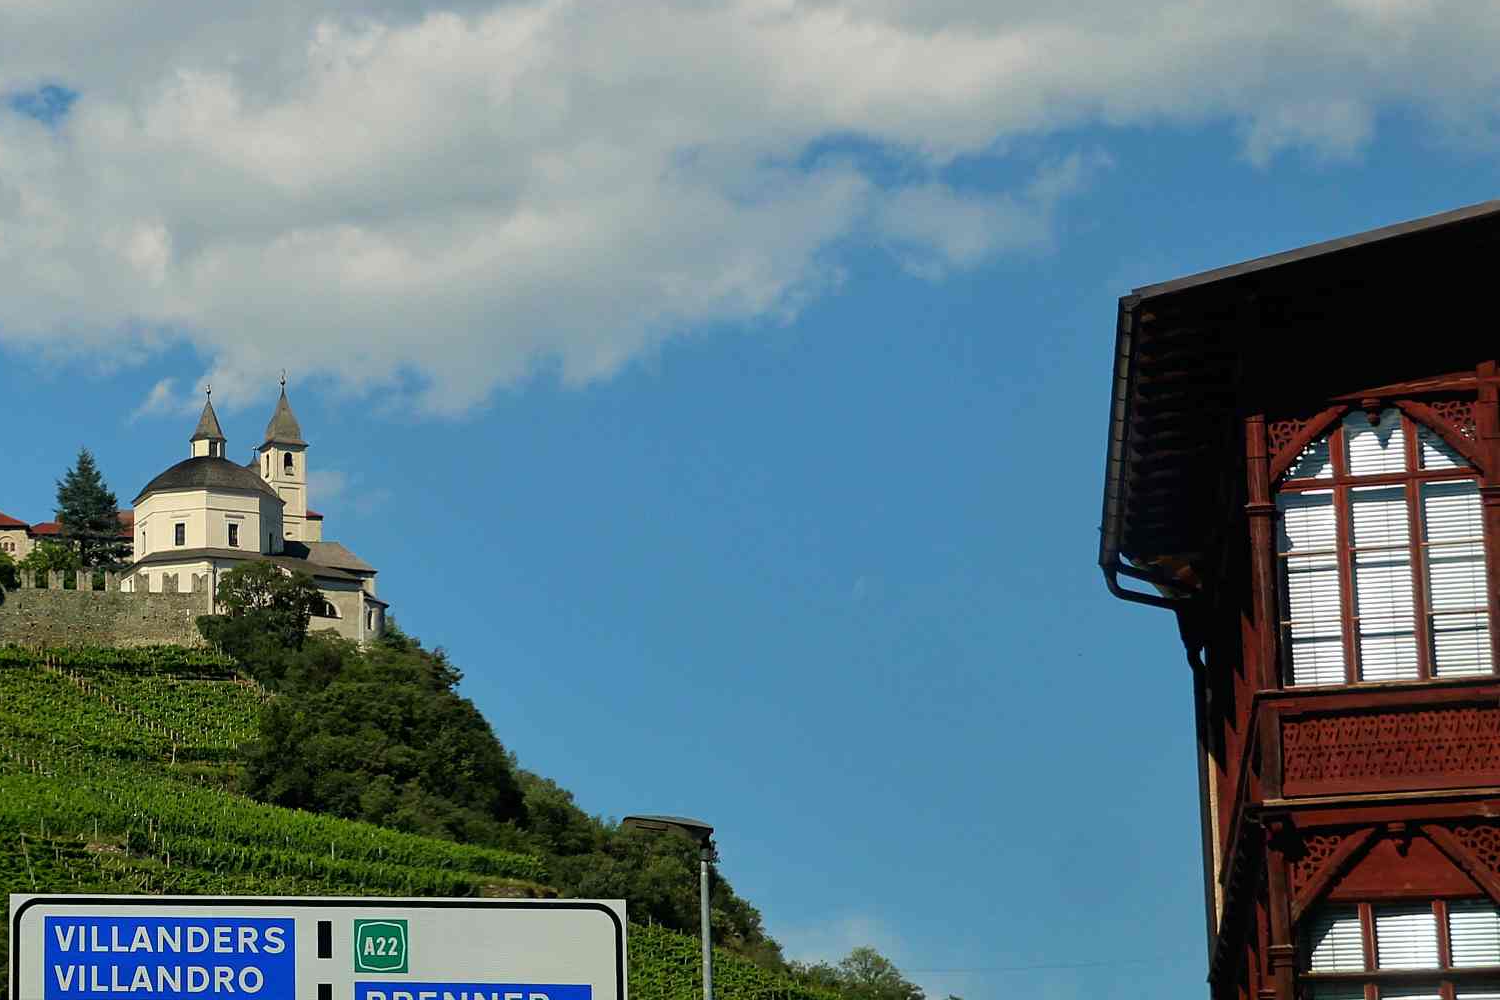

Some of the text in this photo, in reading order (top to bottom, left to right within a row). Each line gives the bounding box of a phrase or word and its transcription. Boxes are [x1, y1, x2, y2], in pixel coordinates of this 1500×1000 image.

[54, 925, 286, 954] VILLANDERS
[363, 936, 398, 956] A22
[54, 965, 264, 993] VILLANDRO
